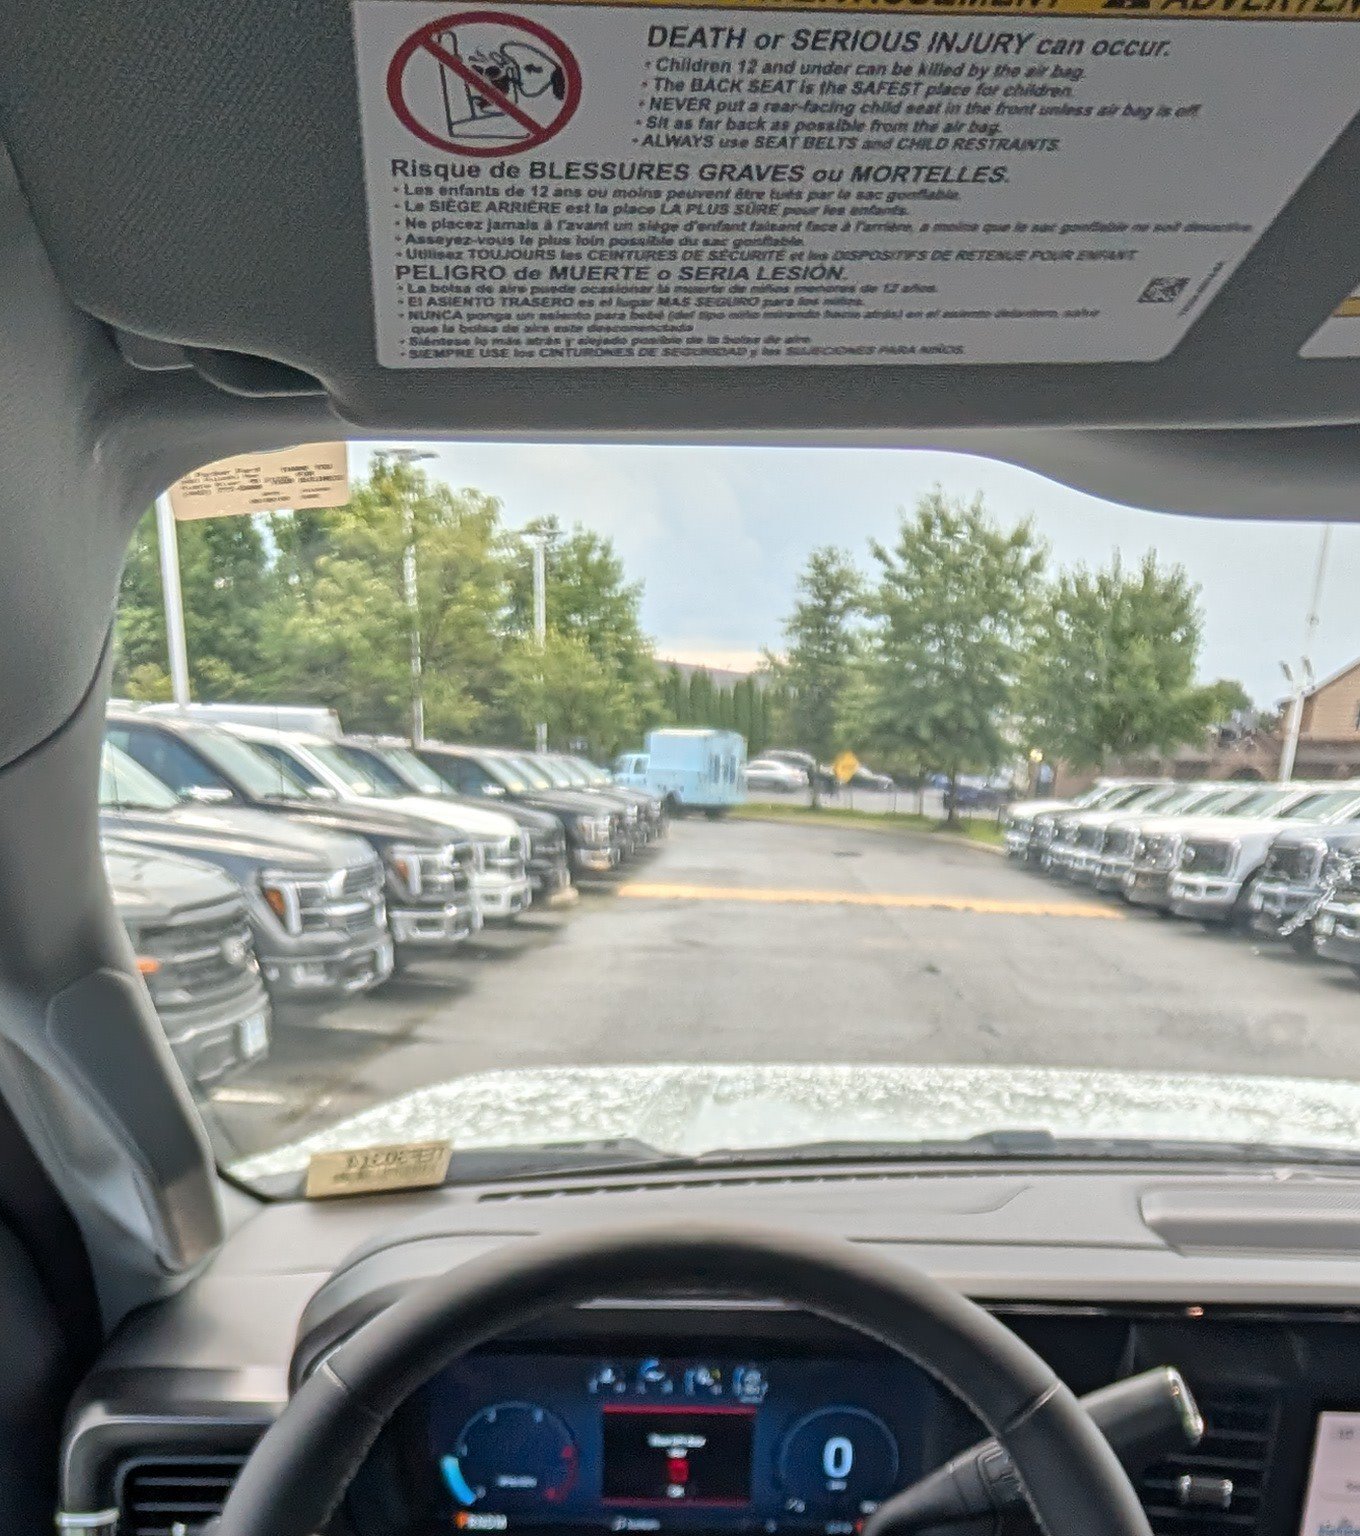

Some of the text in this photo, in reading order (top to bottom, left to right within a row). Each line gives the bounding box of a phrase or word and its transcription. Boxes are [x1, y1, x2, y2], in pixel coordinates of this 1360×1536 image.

[647, 25, 1172, 58] DEATH or SERIOUS INJURY can occur.
[655, 57, 732, 74] Children
[737, 60, 758, 75] 12
[761, 60, 796, 76] and
[799, 61, 852, 77] under
[855, 64, 888, 77] can
[891, 61, 914, 77] be
[918, 61, 965, 78] killed
[967, 63, 990, 81] by
[992, 63, 1025, 78] the
[653, 77, 685, 93] The
[690, 78, 743, 94] BACK
[747, 79, 798, 94] SEAT
[799, 80, 815, 95] is
[819, 80, 848, 96] the
[850, 81, 925, 97] SAFEST
[925, 82, 971, 99] place
[649, 97, 712, 112] NEVER
[859, 100, 902, 114] child
[905, 103, 943, 116] seat
[965, 102, 991, 116] the
[994, 101, 1037, 116] front
[1121, 102, 1153, 120] bag
[645, 115, 670, 130] Sit
[673, 118, 694, 131] as
[697, 116, 723, 131] far
[726, 116, 766, 132] back
[793, 117, 866, 134] possible
[869, 118, 909, 133] from
[912, 119, 939, 133] the
[641, 133, 715, 149] ALWAYS
[717, 137, 749, 149] use
[753, 135, 800, 150] SEAT
[802, 136, 859, 151] BELTS
[896, 136, 950, 151] CHILD
[391, 158, 1010, 184] Risque de BLESSURES GRAVES ou MORTELLES.
[404, 184, 434, 197] Les
[504, 185, 526, 198] de
[404, 200, 425, 213] Le
[565, 202, 591, 215] est
[612, 202, 656, 217] place
[659, 203, 683, 215] LA
[685, 202, 730, 216] PLUS
[405, 217, 428, 230] Ne
[468, 249, 556, 261] TOUJOURS
[395, 264, 507, 281] PELIGRO
[513, 264, 542, 281] de
[548, 265, 652, 282] MUERTE
[656, 268, 672, 281] o
[677, 266, 750, 281] SERIA
[822, 1435, 854, 1479] 0
